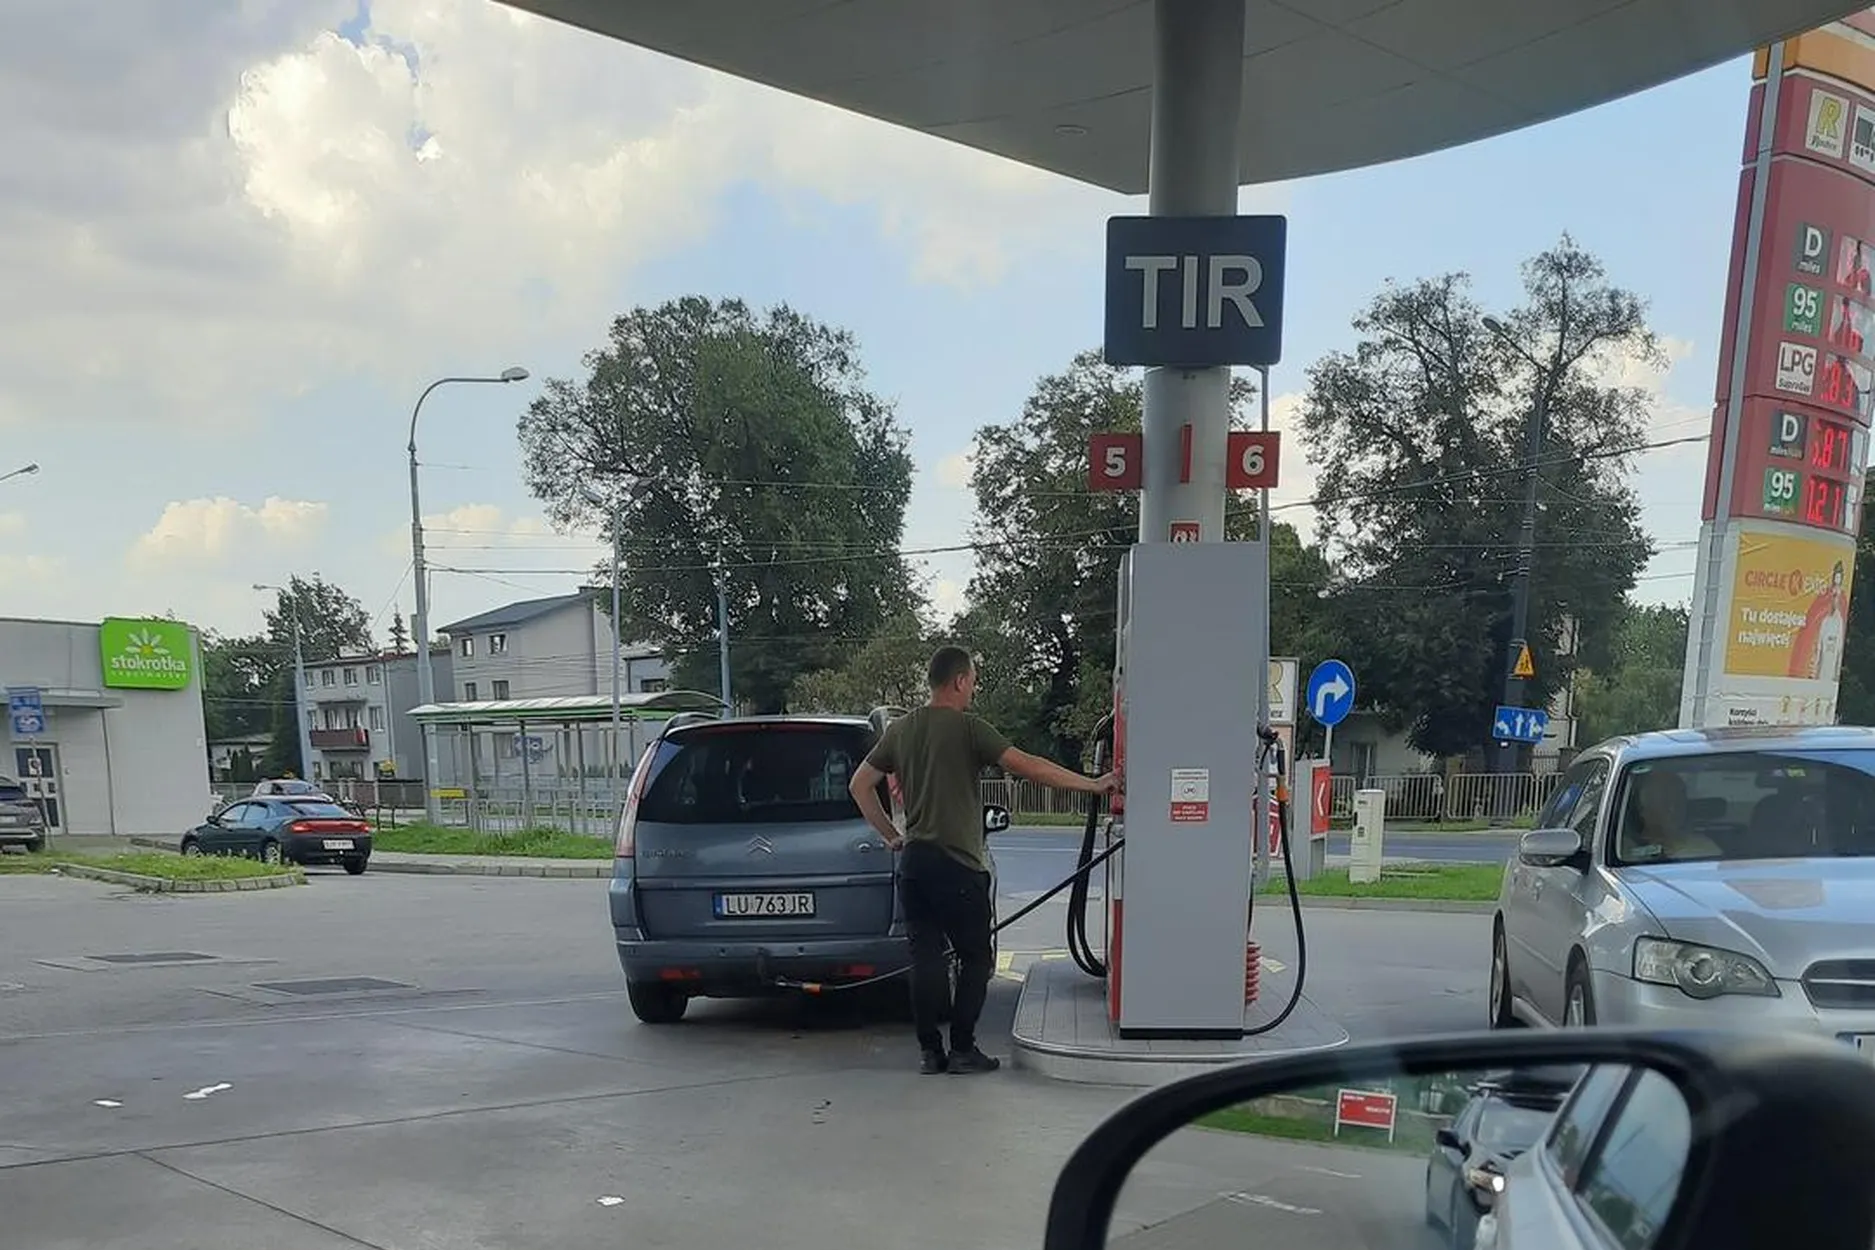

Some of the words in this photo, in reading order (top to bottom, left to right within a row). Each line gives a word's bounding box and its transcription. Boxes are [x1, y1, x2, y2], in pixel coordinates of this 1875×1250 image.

[1804, 226, 1823, 257] D
[1125, 255, 1265, 329] TIR
[1793, 287, 1818, 319] 95
[1780, 347, 1814, 376] LPG
[1781, 414, 1799, 442] D
[1104, 446, 1126, 477] 5
[1242, 445, 1266, 475] 6
[1771, 471, 1795, 499] 95
[1745, 570, 1787, 591] CIRCLE
[1741, 608, 1759, 624] Tu
[111, 654, 187, 672] stokrotka
[726, 896, 749, 914] LU
[755, 895, 809, 914] 763JR
